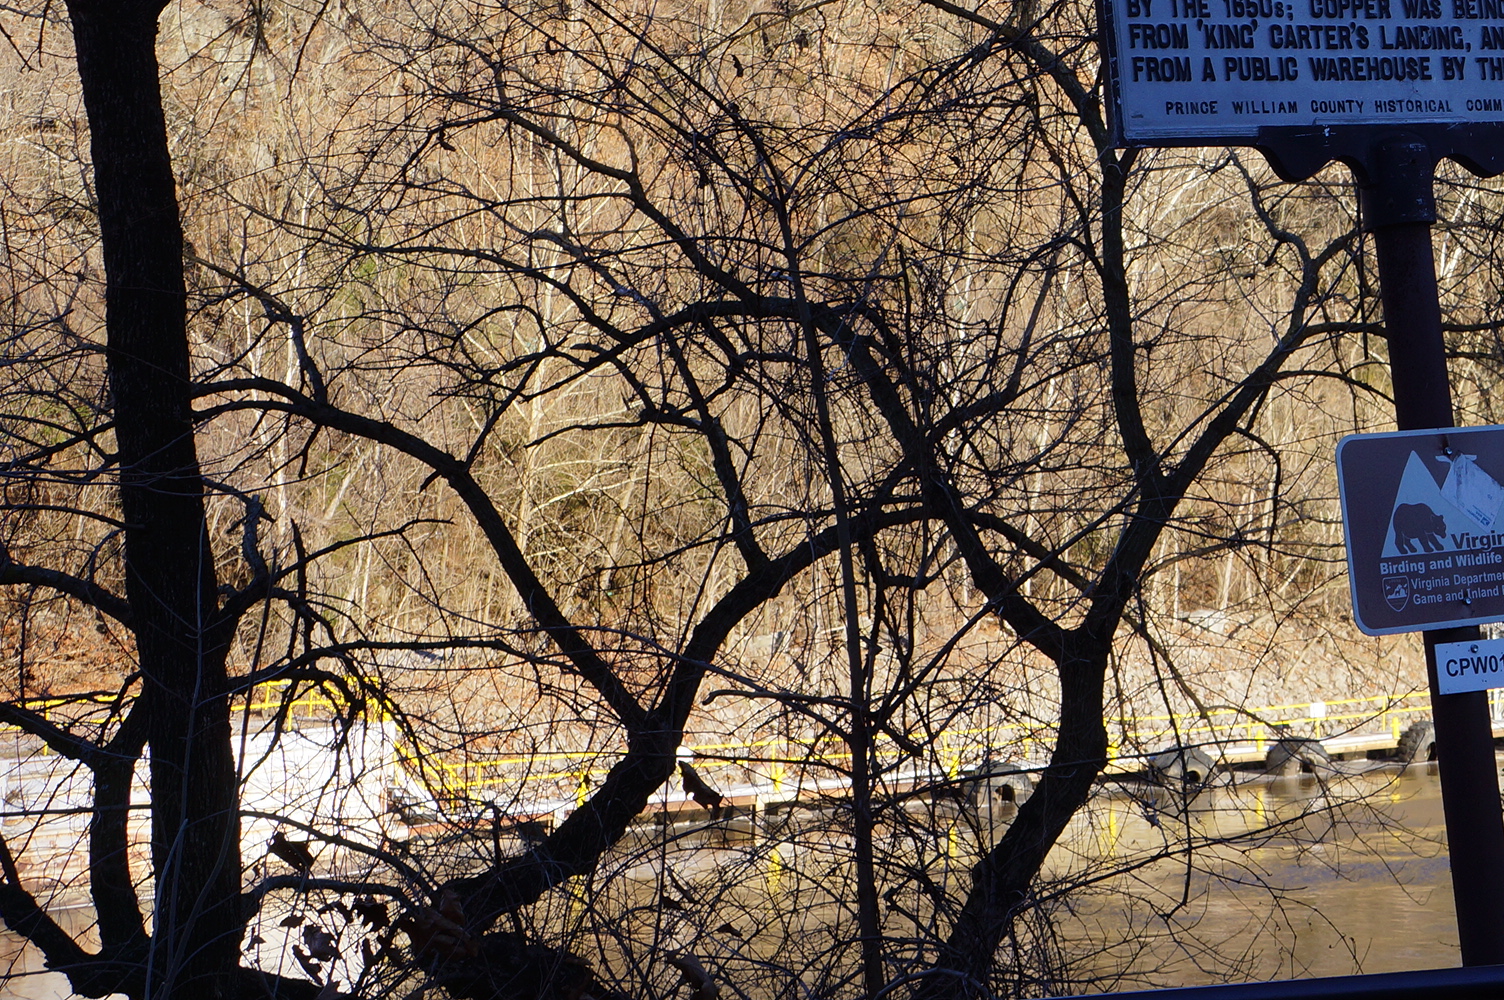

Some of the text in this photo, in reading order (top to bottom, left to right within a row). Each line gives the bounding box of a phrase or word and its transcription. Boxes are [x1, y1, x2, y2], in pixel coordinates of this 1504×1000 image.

[1127, 23, 1189, 50] FROM
[1268, 21, 1369, 51] CARTER'S
[1378, 25, 1471, 53] LANDING,
[1131, 56, 1192, 83] FROM
[1201, 57, 1216, 82] A
[1223, 56, 1298, 82] PUBLIC
[1307, 56, 1432, 82] WAREHOUSE
[1440, 56, 1466, 81] BY
[1165, 100, 1218, 115] PRINCE
[1231, 100, 1298, 114] WILLIAM
[1310, 99, 1364, 114] COUNTY
[1374, 99, 1453, 113] HISTORICAL
[1380, 560, 1425, 575] Birding
[1430, 556, 1453, 570] and
[1455, 552, 1502, 567] Wildlife
[1410, 576, 1450, 591] Virginia
[1413, 594, 1443, 605] Game
[1445, 588, 1464, 601] and
[1466, 585, 1499, 600] Inland
